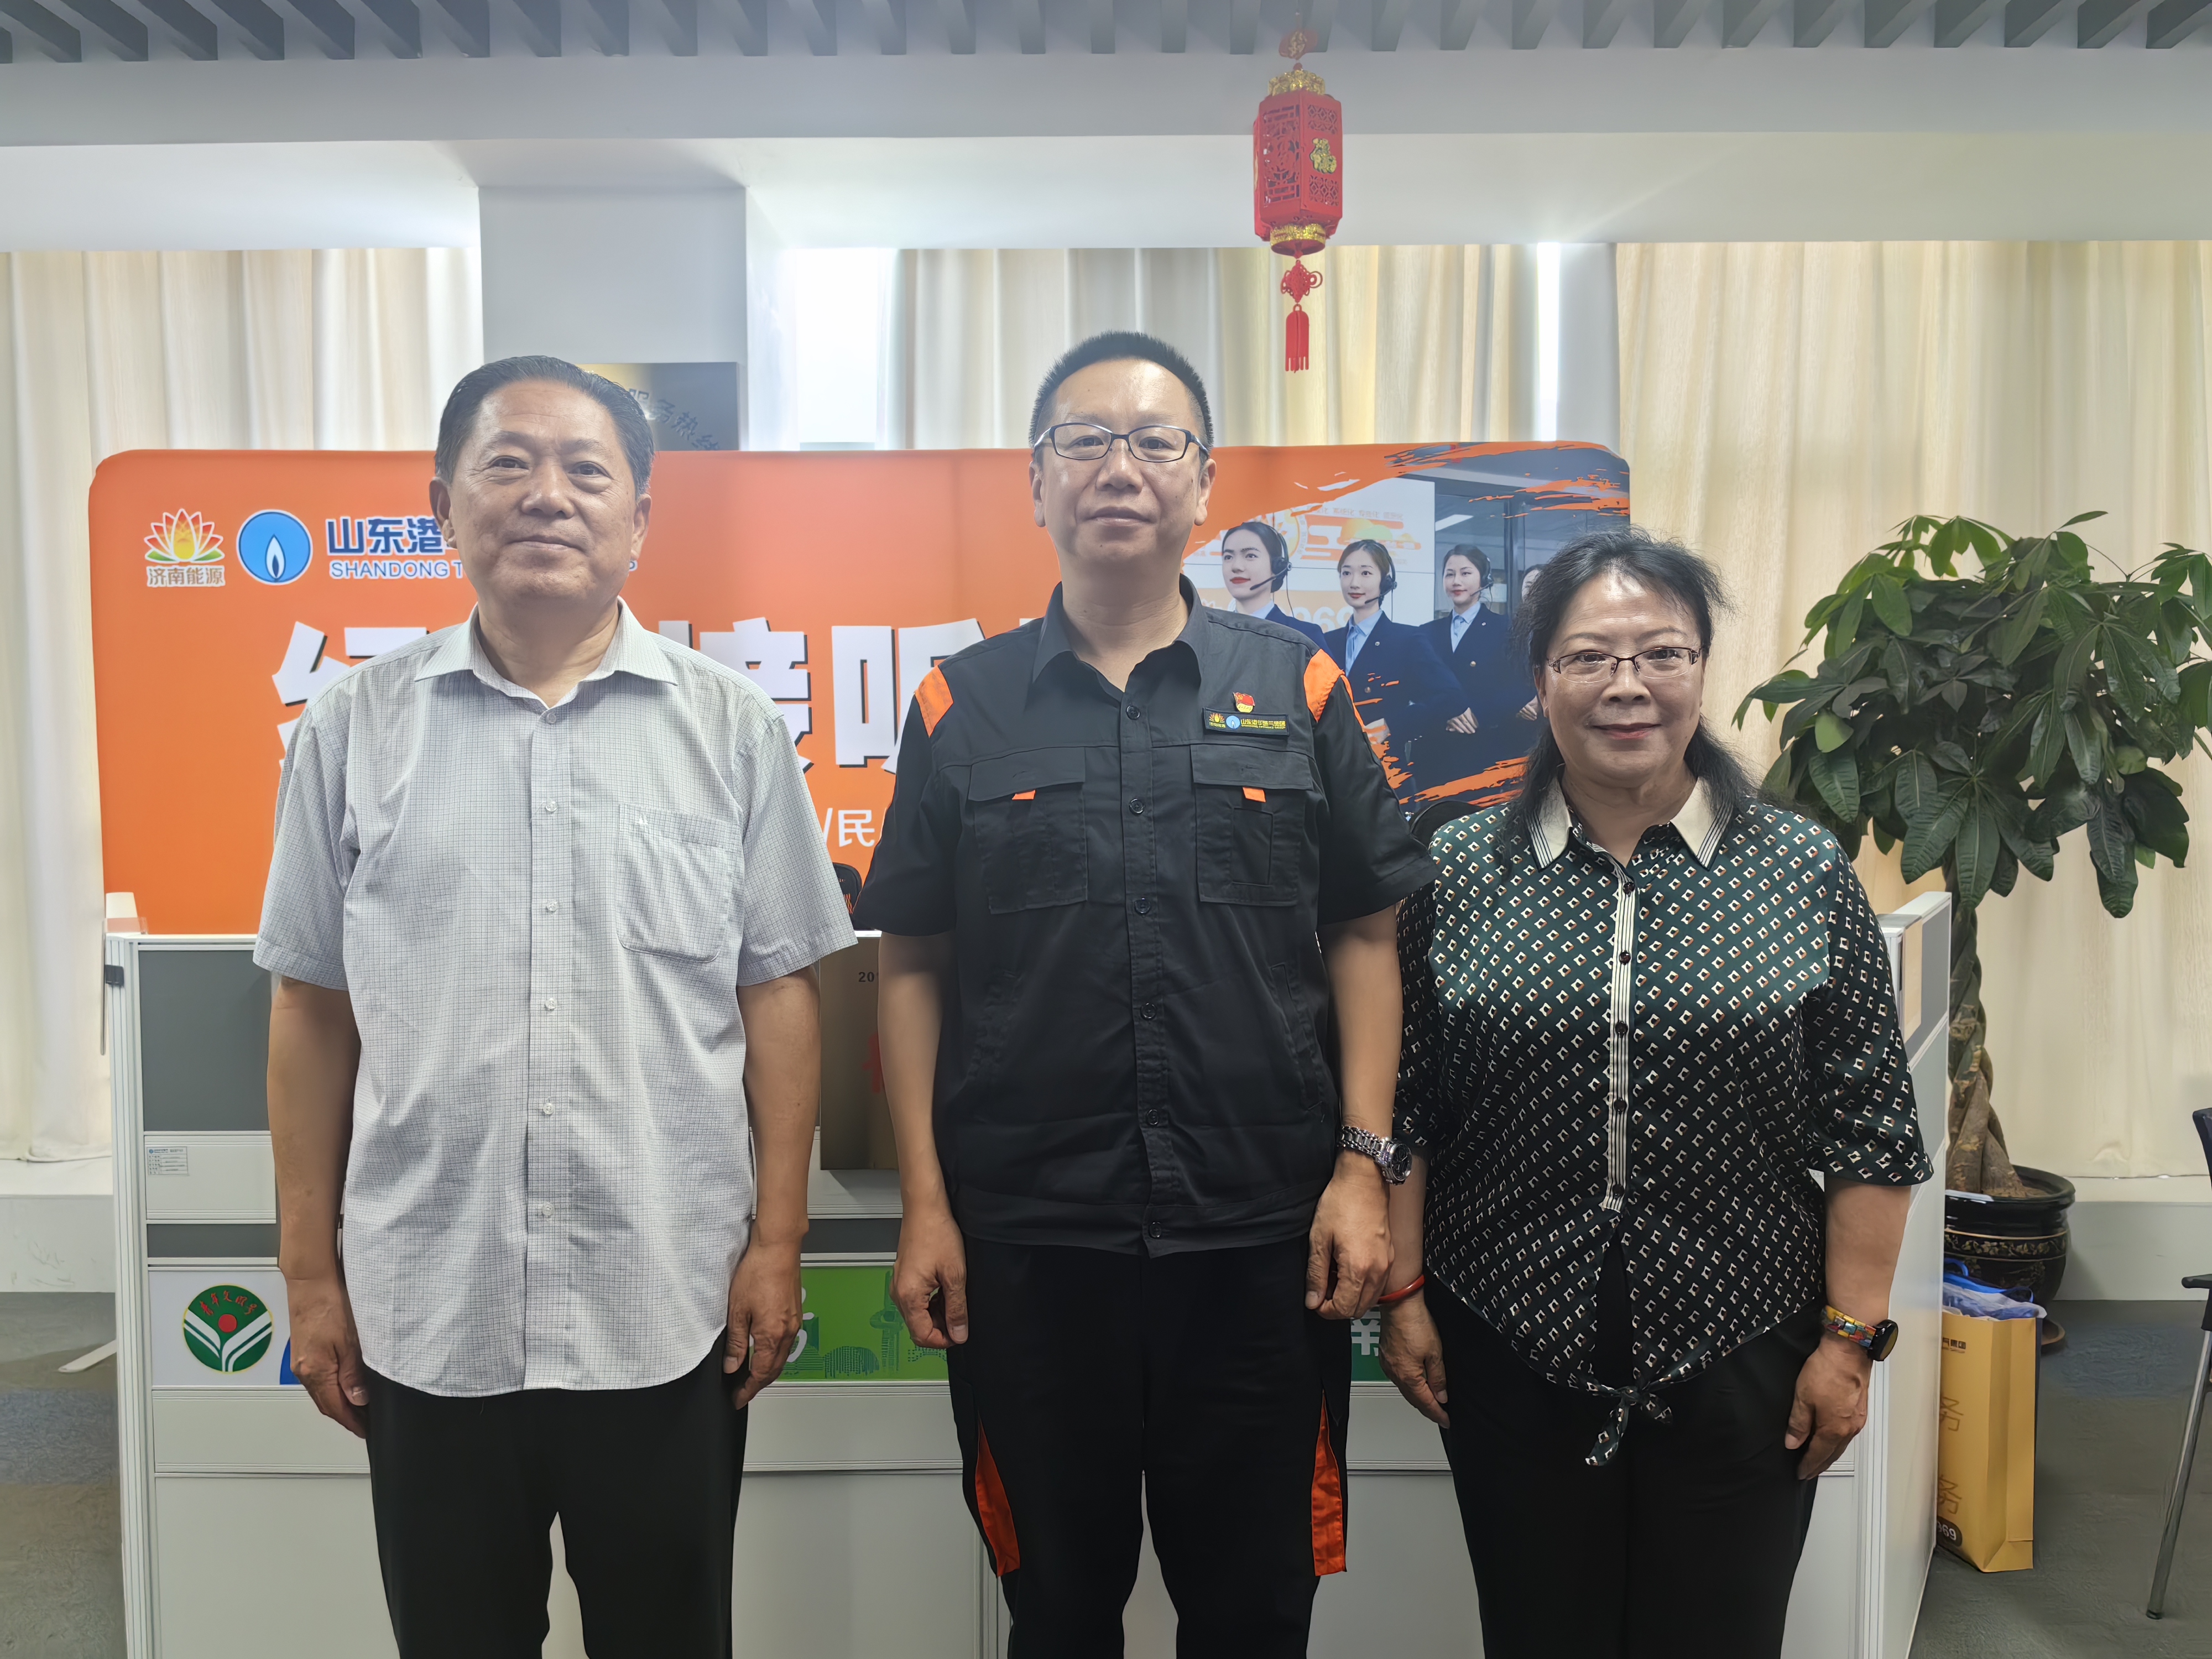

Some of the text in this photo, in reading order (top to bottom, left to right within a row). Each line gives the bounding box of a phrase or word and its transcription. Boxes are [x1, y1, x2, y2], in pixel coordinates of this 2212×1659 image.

[148, 567, 223, 585] 济南能源
[331, 561, 448, 577] SHANDONG
